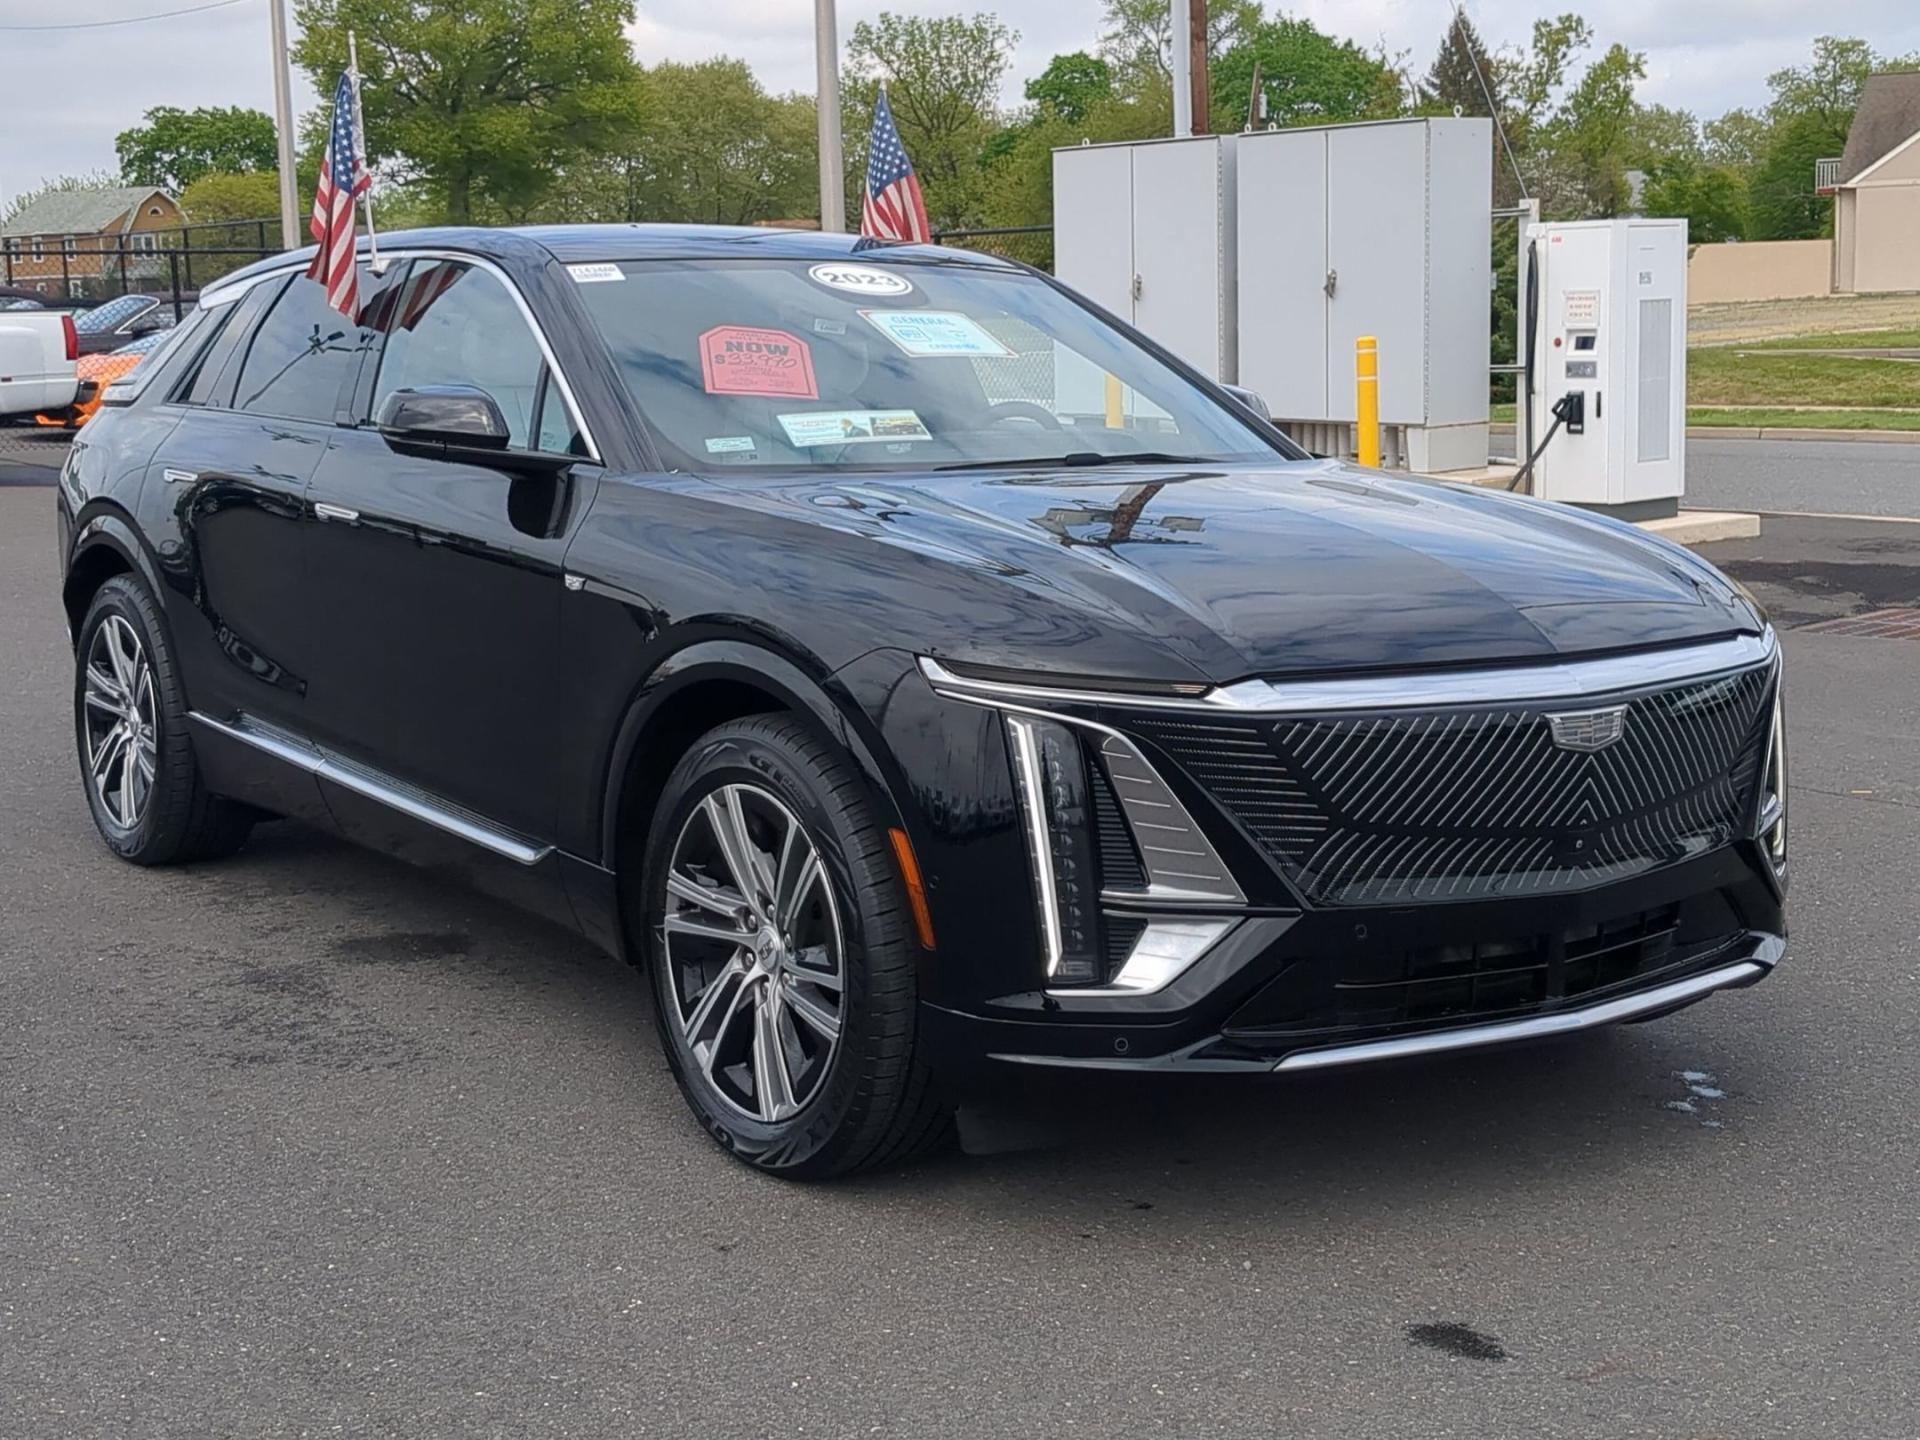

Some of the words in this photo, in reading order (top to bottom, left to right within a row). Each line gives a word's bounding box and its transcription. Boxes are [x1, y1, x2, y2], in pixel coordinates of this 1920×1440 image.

[822, 272, 900, 287] 2023
[891, 316, 956, 326] GENERAL
[725, 341, 790, 357] NOW
